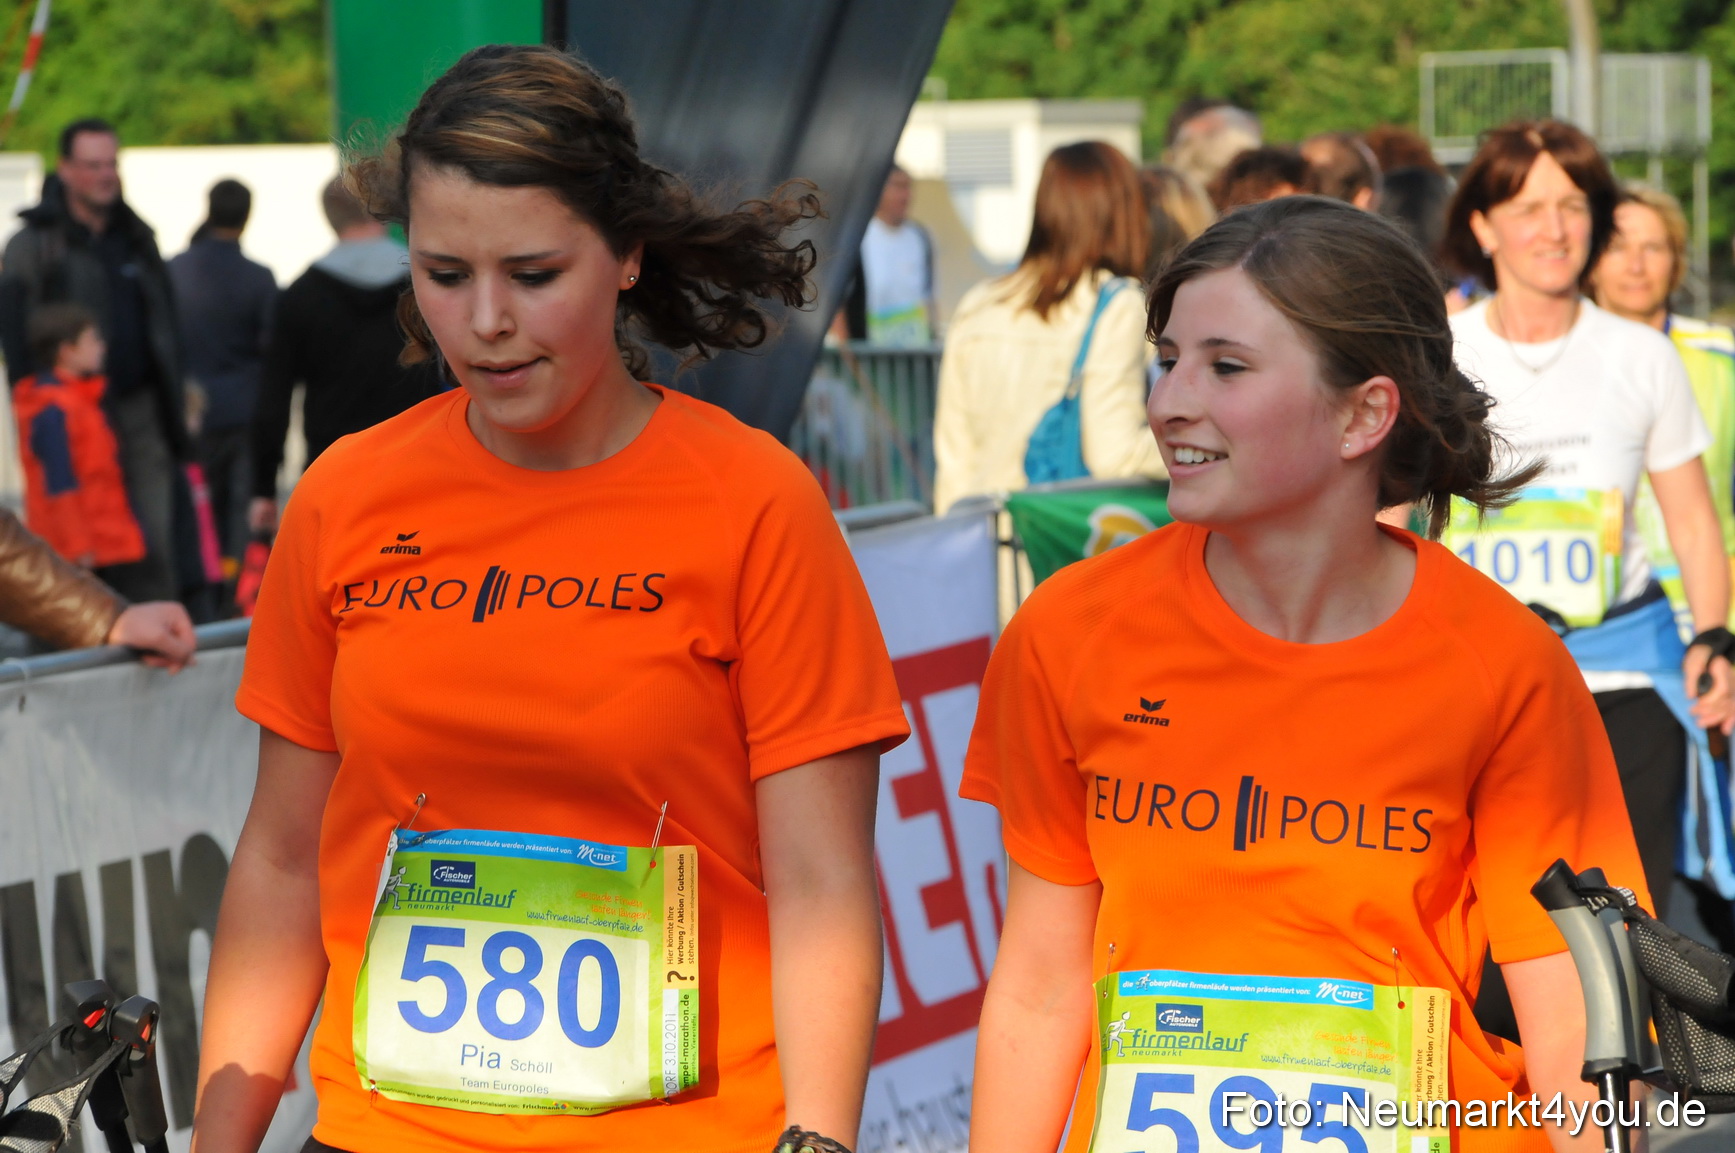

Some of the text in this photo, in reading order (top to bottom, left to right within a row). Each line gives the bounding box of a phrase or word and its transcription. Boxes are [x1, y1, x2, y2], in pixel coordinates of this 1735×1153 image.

[380, 544, 421, 555] erima
[1457, 539, 1595, 585] 1010
[339, 572, 666, 614] EURO POLES
[1123, 712, 1170, 727] erima
[1094, 775, 1434, 854] EURO POLES
[424, 838, 462, 846] oberpfälzer
[463, 839, 500, 848] firmenläufe
[525, 844, 560, 854] präsentiert
[577, 844, 621, 865] M-net
[441, 866, 473, 880] Fischer
[407, 883, 517, 909] firmenlauf
[407, 903, 455, 911] neumarkt
[526, 909, 644, 932] www.firmenlauf-oberpfalz.de
[677, 898, 685, 924] Aktion
[666, 906, 674, 965] Hier könnte Ihre
[677, 930, 686, 965] Werbung
[397, 924, 621, 1049] 580
[1150, 980, 1188, 989] oberpfälzer
[1190, 981, 1229, 991] firmenläufe
[1256, 986, 1294, 994] präsentiert
[1316, 982, 1370, 1004] M-net
[1166, 1010, 1201, 1024] Fischer
[1428, 996, 1436, 1034] Gutschein
[664, 1013, 677, 1066] 3.10.2011
[1131, 1028, 1249, 1052] firmenlauf
[460, 1043, 553, 1075] Pia Schöll
[1131, 1048, 1182, 1057] neumarkt
[1416, 1049, 1424, 1065] Ihre
[1426, 1041, 1434, 1068] Aktion
[1260, 1053, 1392, 1076] www.firmenlauf-oberpfalz.de
[460, 1076, 549, 1095] Team Europoles
[1416, 1066, 1424, 1092] könnte
[470, 1100, 506, 1108] personalisiert
[1123, 1072, 1369, 1153] 595
